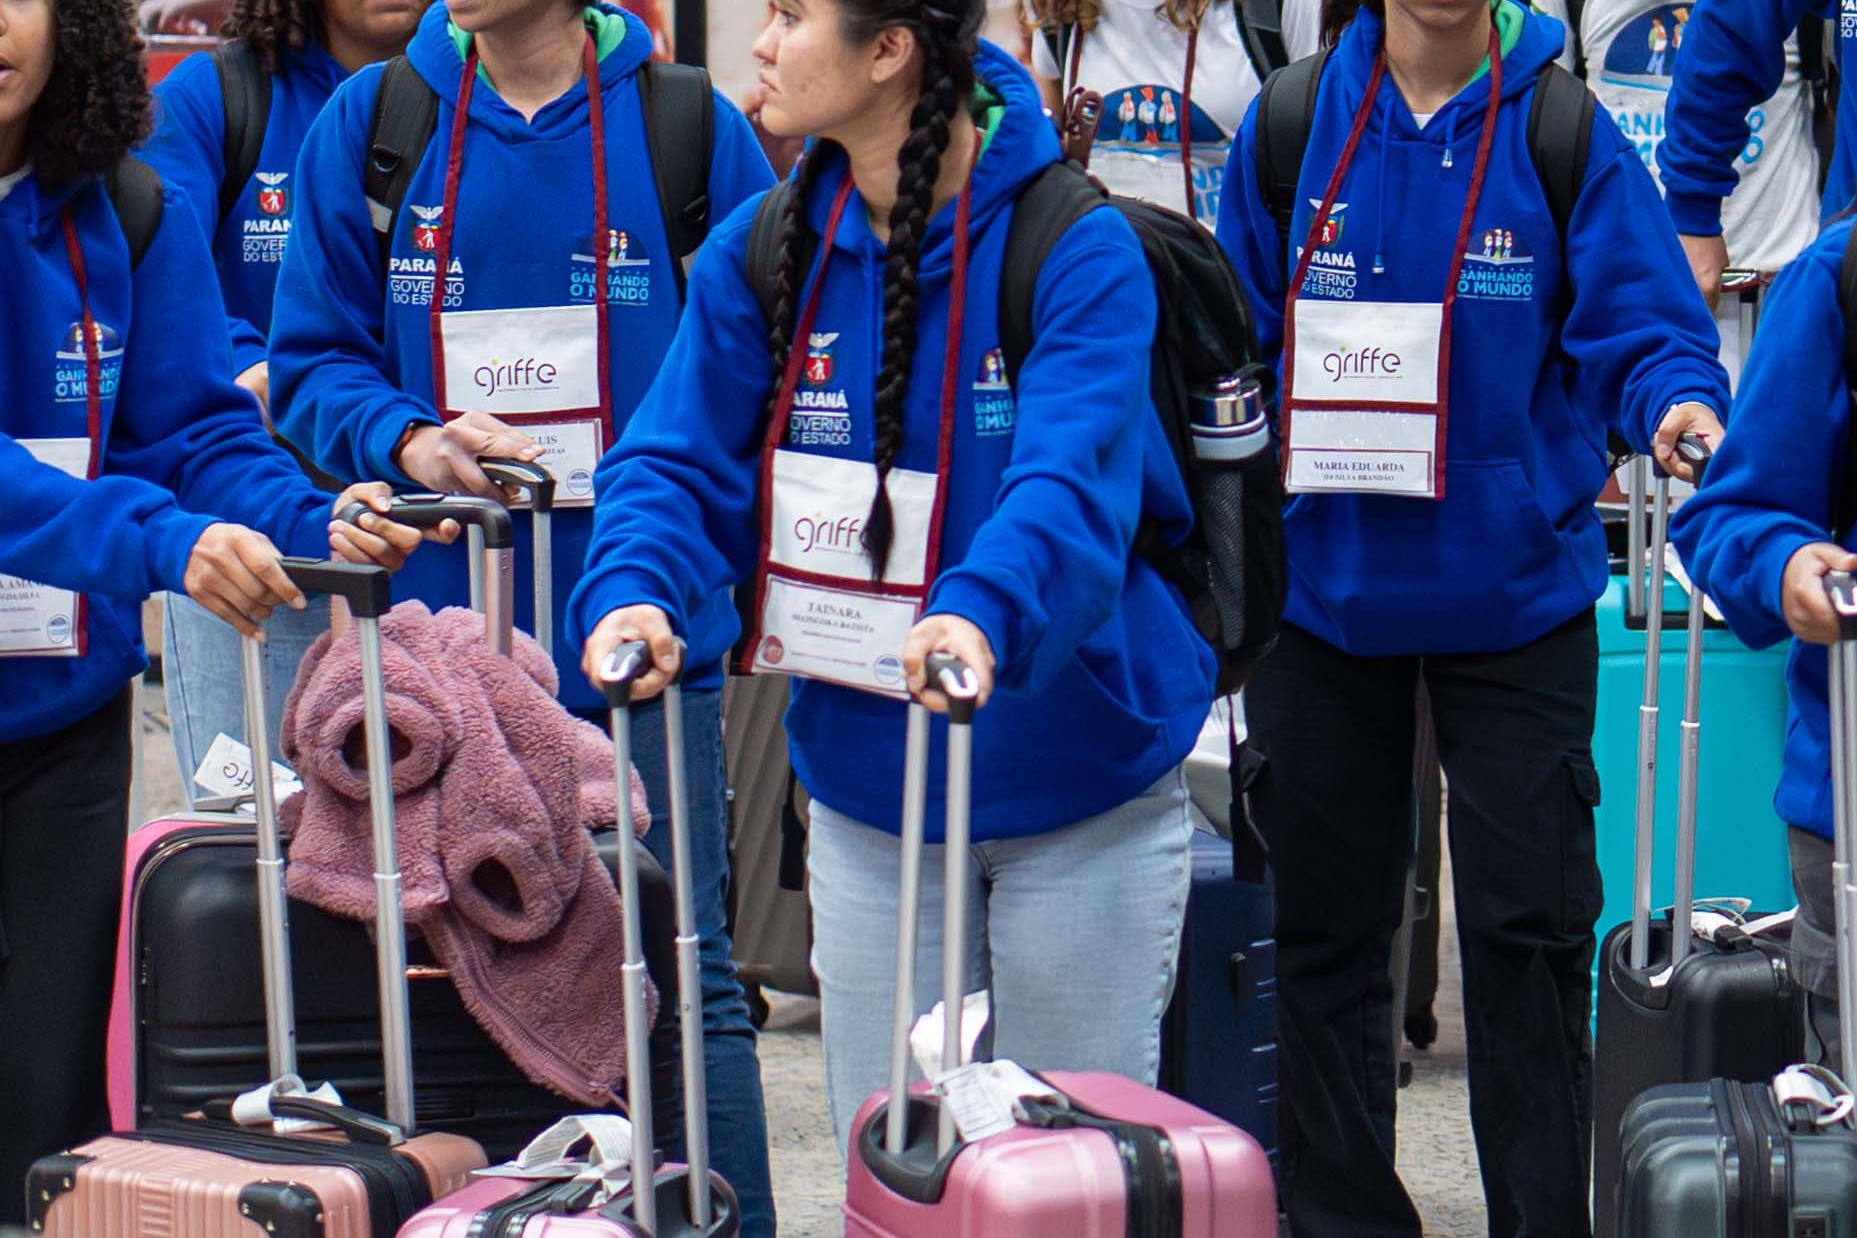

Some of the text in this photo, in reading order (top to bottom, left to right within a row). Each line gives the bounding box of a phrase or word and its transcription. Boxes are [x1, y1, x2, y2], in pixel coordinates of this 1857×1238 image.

[243, 252, 260, 262] DO
[1296, 245, 1356, 268] PRANÁ
[390, 256, 464, 274] PARAÁ
[570, 271, 650, 287] GAANDO
[1459, 268, 1533, 283] GANHANDO
[569, 283, 584, 297] O
[1311, 283, 1355, 299] ESTADO
[1457, 280, 1533, 296] O MUNDO
[392, 292, 463, 307] DO ESTDO
[1323, 346, 1401, 382] griffe
[474, 358, 557, 397] griffe
[794, 388, 849, 409] ARANÁ
[790, 416, 852, 432] OVERNO
[801, 431, 851, 445] ESTADO
[1313, 461, 1405, 472] MARIA EDUARDA
